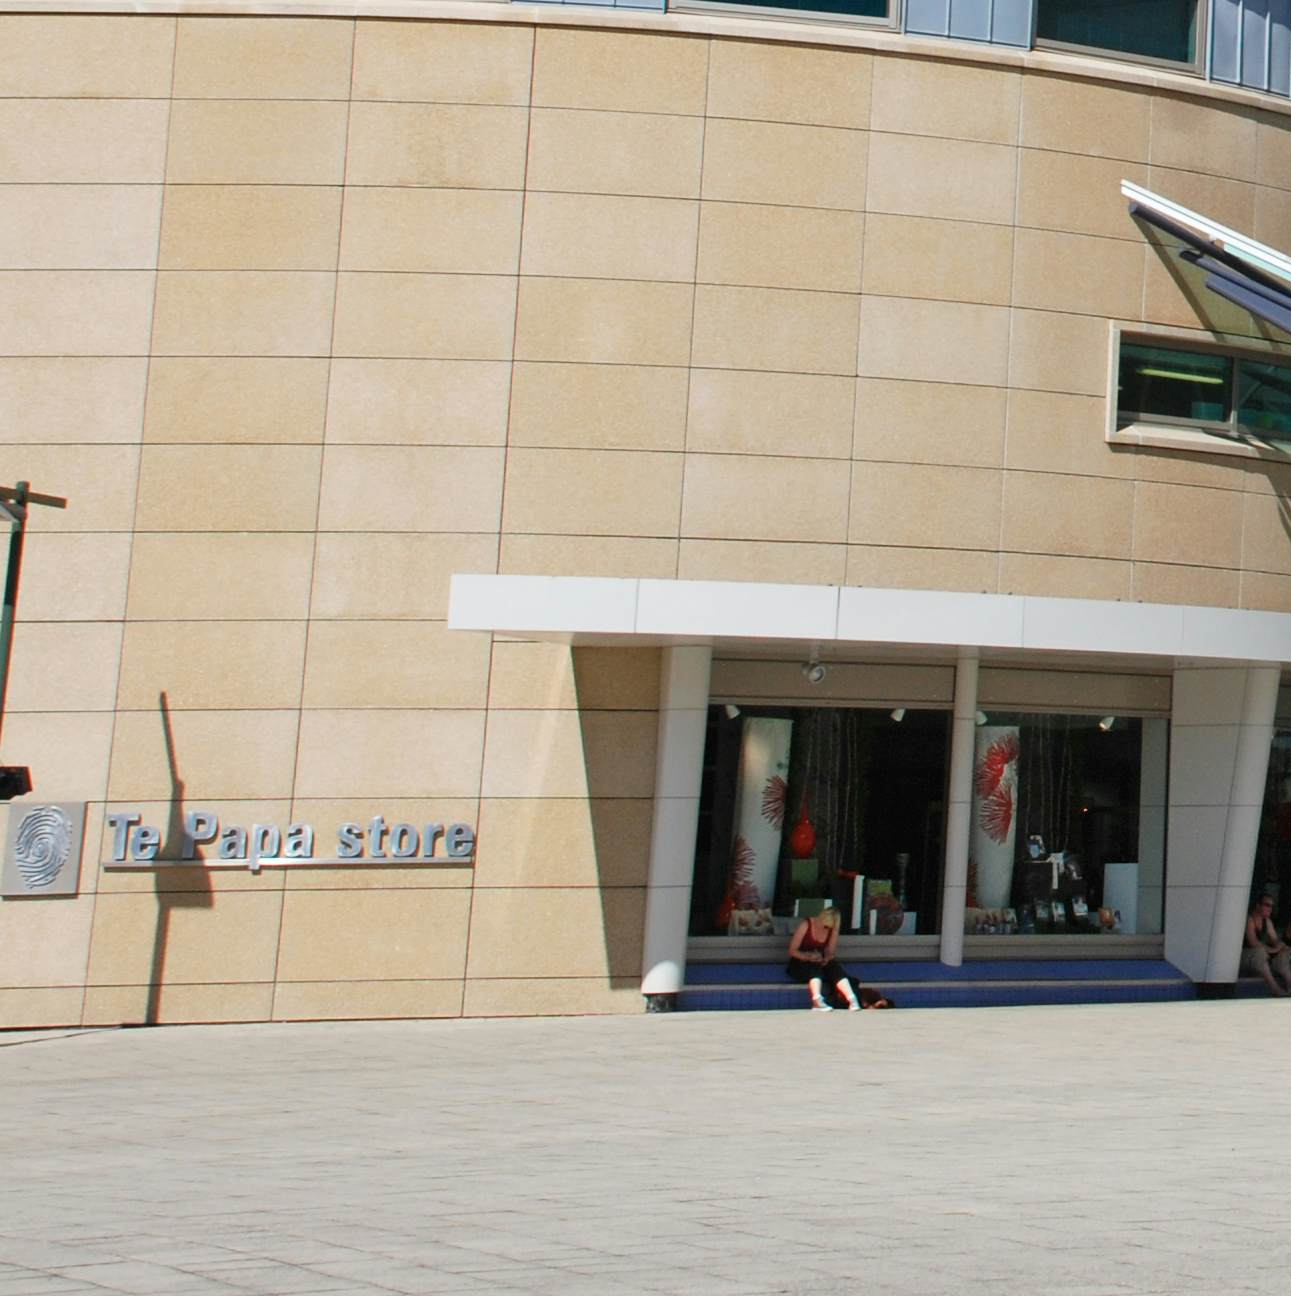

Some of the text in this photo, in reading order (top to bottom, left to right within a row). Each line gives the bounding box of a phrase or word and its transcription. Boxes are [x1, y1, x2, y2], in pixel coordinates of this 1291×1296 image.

[108, 810, 476, 874] Te Papa store
